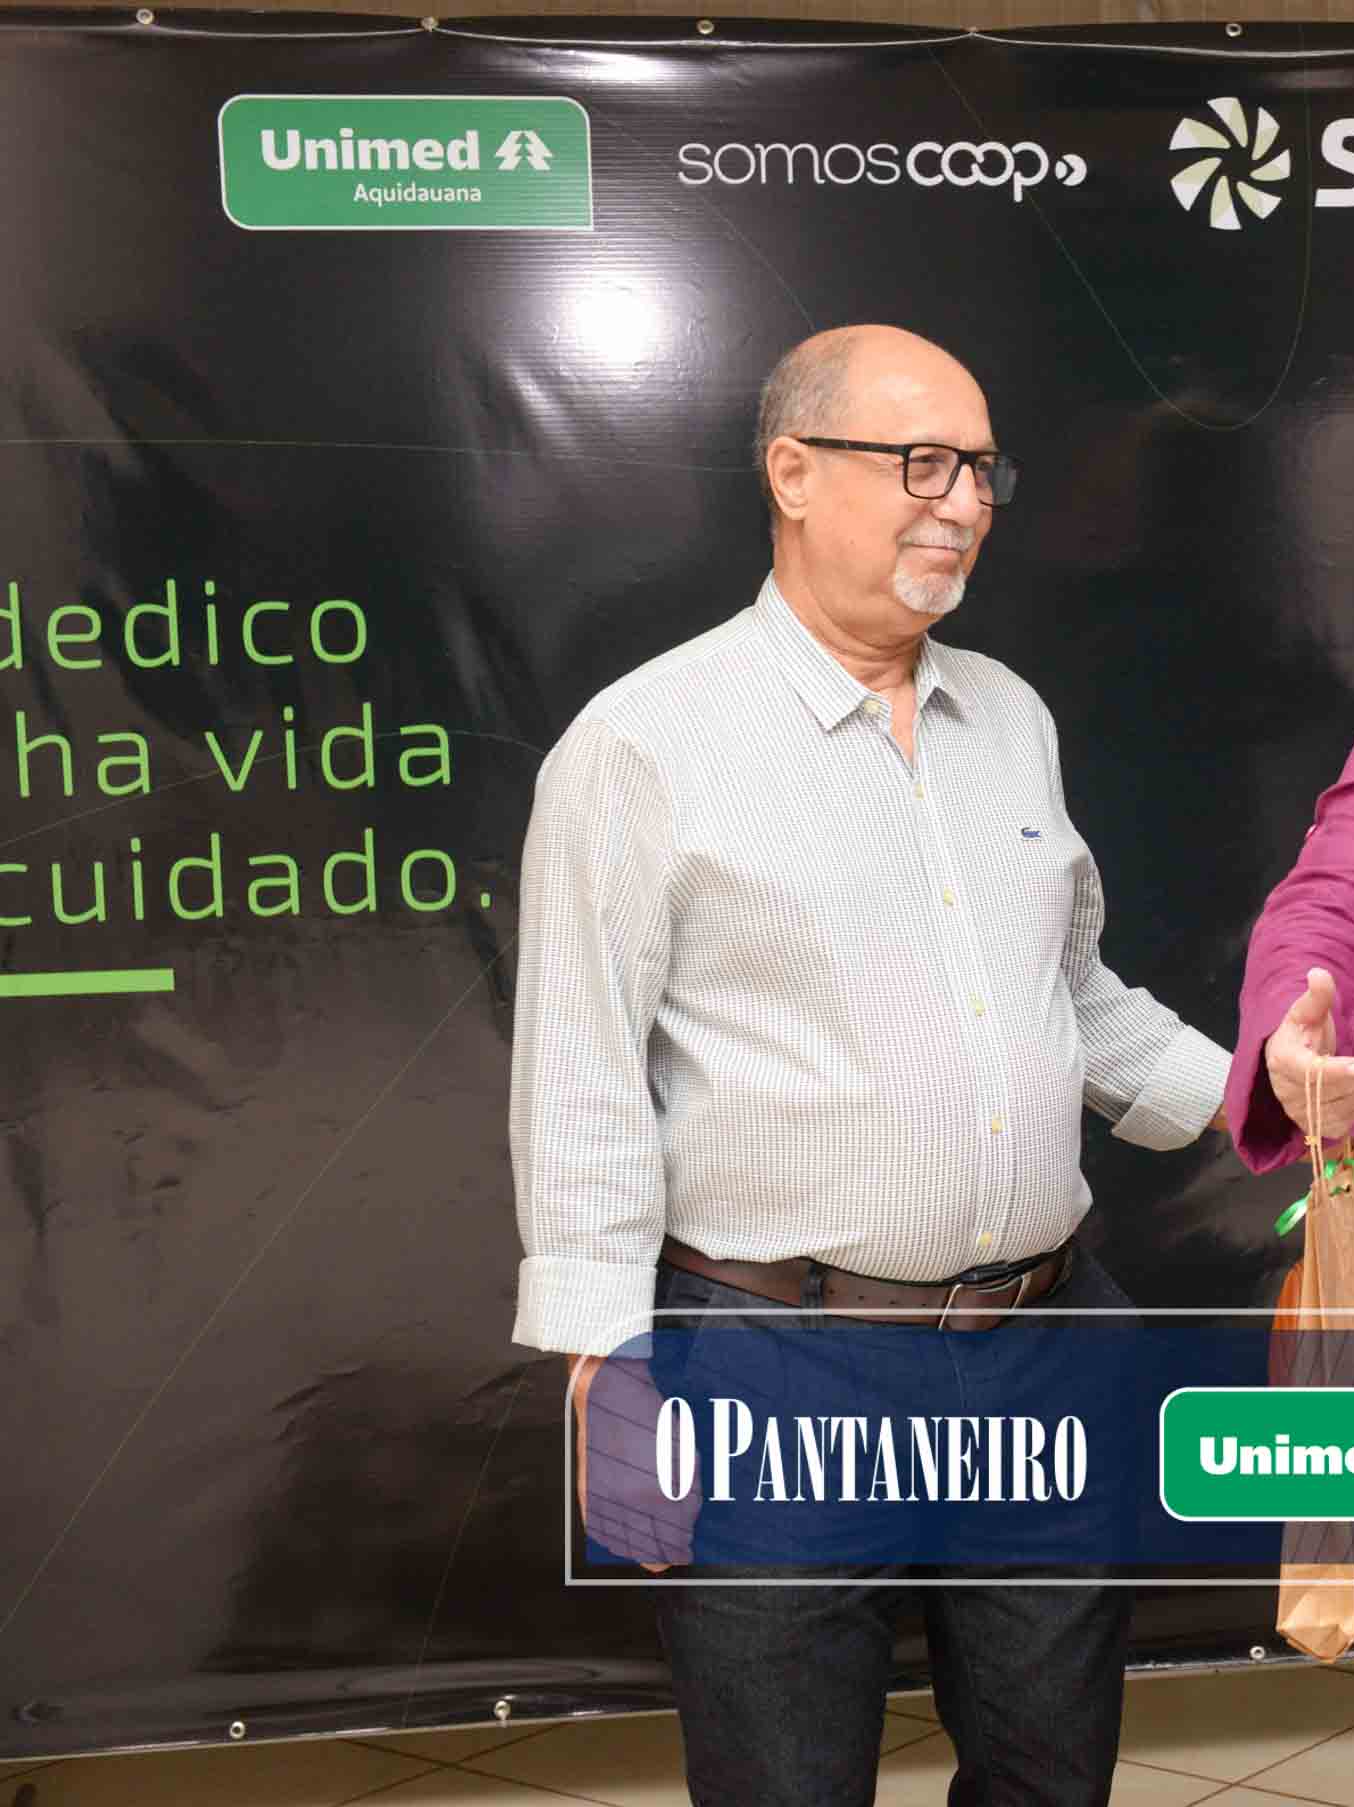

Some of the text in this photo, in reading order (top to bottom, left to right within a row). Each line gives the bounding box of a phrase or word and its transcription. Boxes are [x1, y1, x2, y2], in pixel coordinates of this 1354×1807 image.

[260, 128, 481, 172] Unimed
[353, 182, 483, 209] Aquidauana
[205, 701, 451, 794] vida
